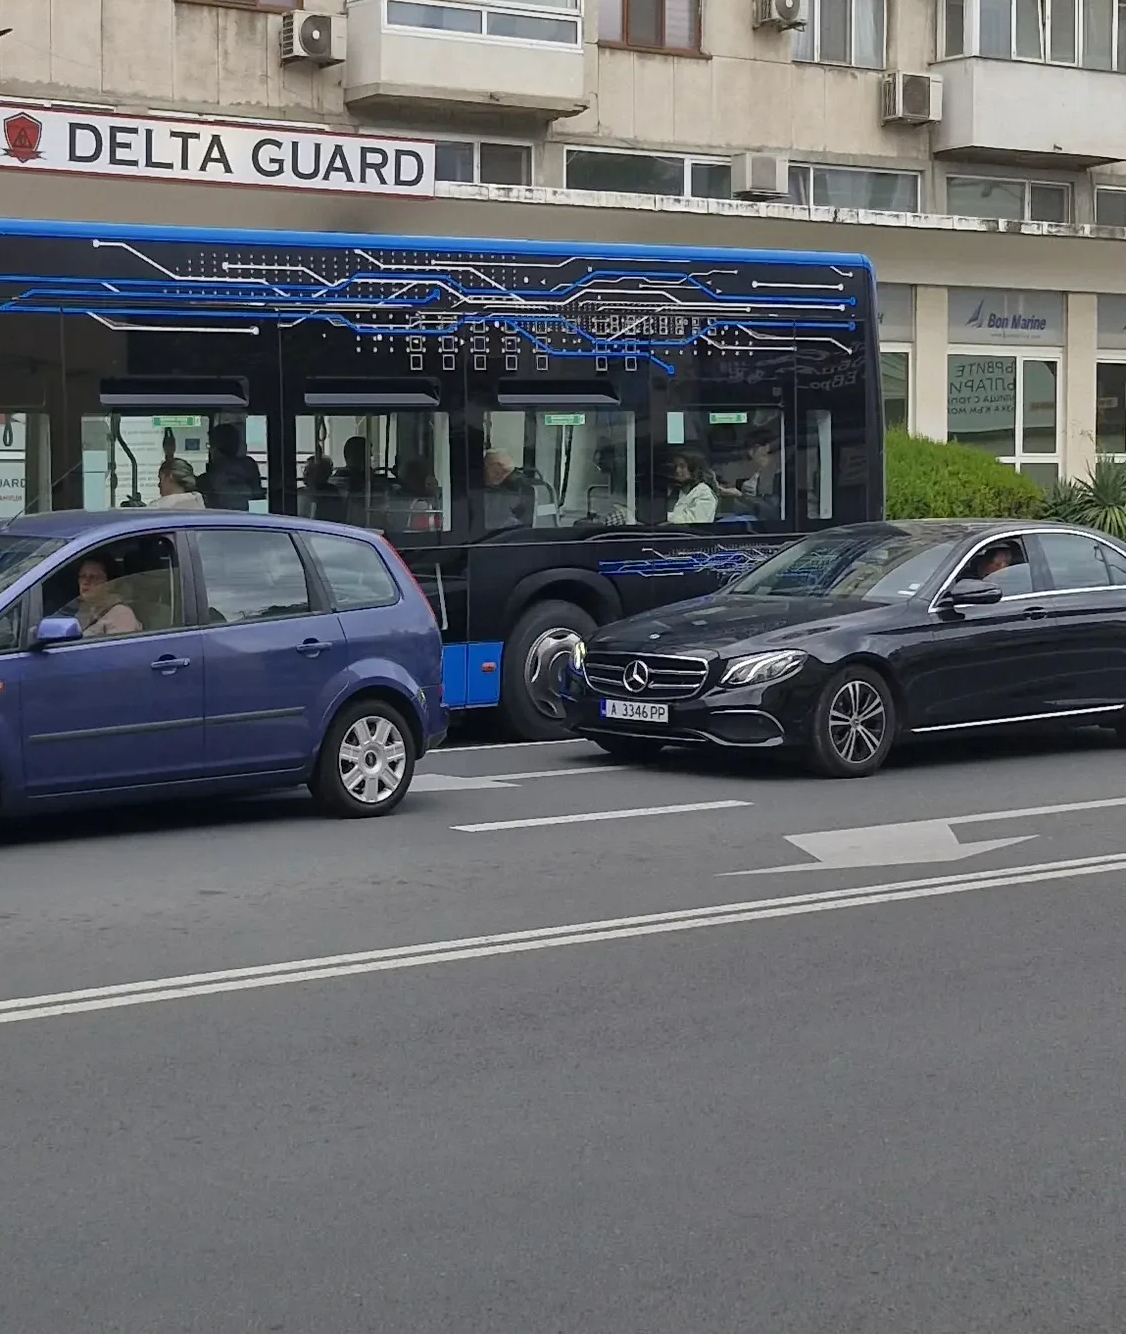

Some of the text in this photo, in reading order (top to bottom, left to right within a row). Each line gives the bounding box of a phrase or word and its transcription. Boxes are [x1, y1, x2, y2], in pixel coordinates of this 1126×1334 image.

[67, 121, 425, 187] DELTA GUARD
[987, 312, 1047, 331] Bon Marine
